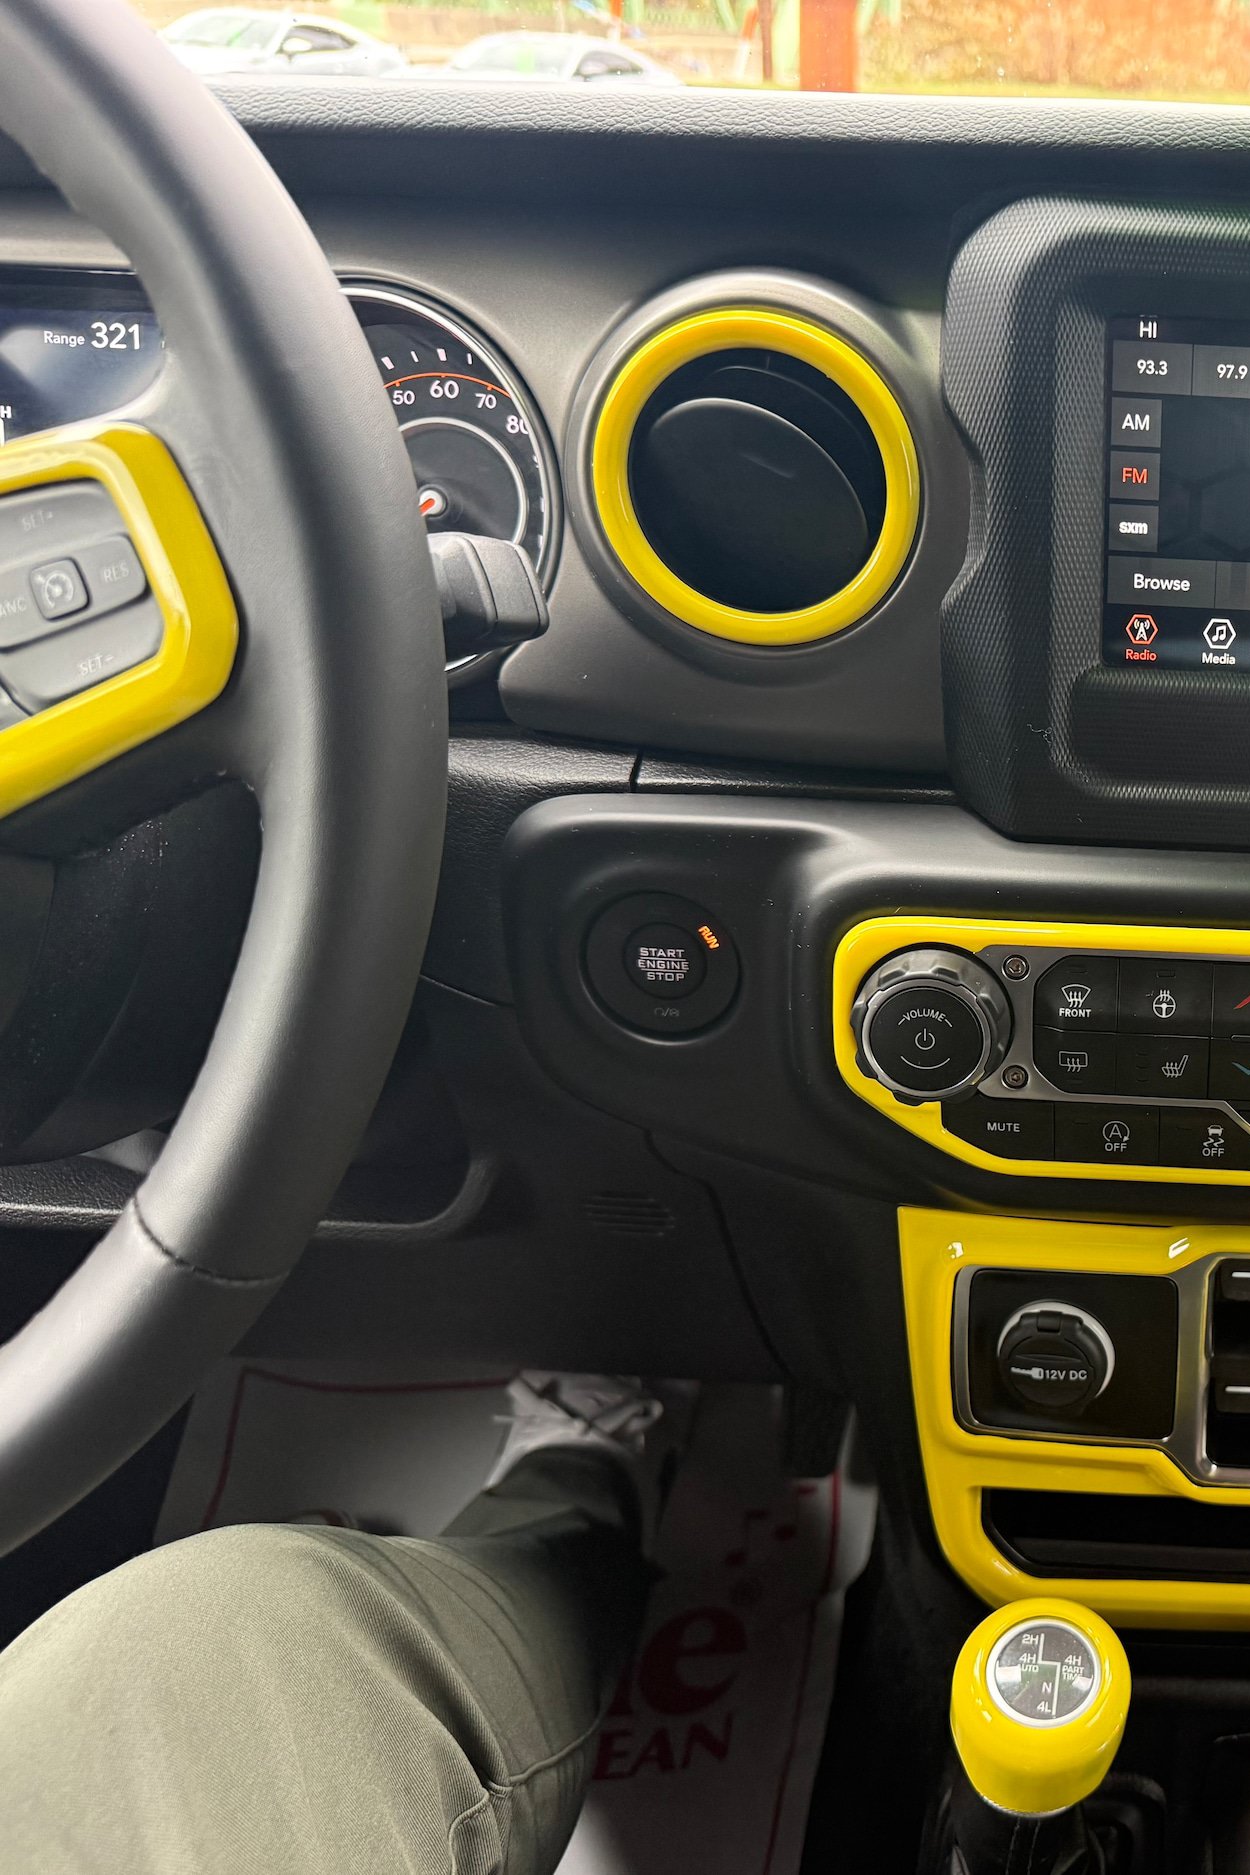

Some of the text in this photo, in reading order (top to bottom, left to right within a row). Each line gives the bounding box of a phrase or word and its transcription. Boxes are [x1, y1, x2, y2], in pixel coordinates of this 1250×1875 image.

[44, 322, 140, 350] Range 321
[1139, 321, 1157, 338] HI
[1137, 359, 1168, 376] 93.3
[1216, 363, 1248, 380] 97.9
[429, 380, 459, 399] 60
[392, 390, 416, 405] 50
[475, 393, 497, 409] 70
[1121, 413, 1150, 431] AM
[1122, 467, 1148, 484] FM
[1118, 521, 1148, 535] sxm
[103, 562, 130, 583] RES
[1133, 573, 1191, 592] Browse
[1125, 649, 1157, 662] Radio
[1201, 652, 1236, 665] Media
[698, 925, 720, 950] RUN
[639, 947, 685, 958] START
[638, 959, 689, 970] ENGINE
[647, 971, 685, 981] STOP
[902, 1009, 946, 1022] VOLUME
[1058, 1007, 1092, 1019] FRONT
[986, 1122, 1021, 1133] MUTE
[1104, 1142, 1128, 1153] OFF
[1201, 1147, 1225, 1158] OFF
[1045, 1370, 1088, 1380] 12V DC
[1021, 1633, 1039, 1645] 2H
[1019, 1653, 1036, 1664] 4H
[1064, 1655, 1082, 1666] 4H
[1062, 1665, 1084, 1674] PART
[1041, 1682, 1052, 1693] N
[1036, 1701, 1051, 1712] 4L
